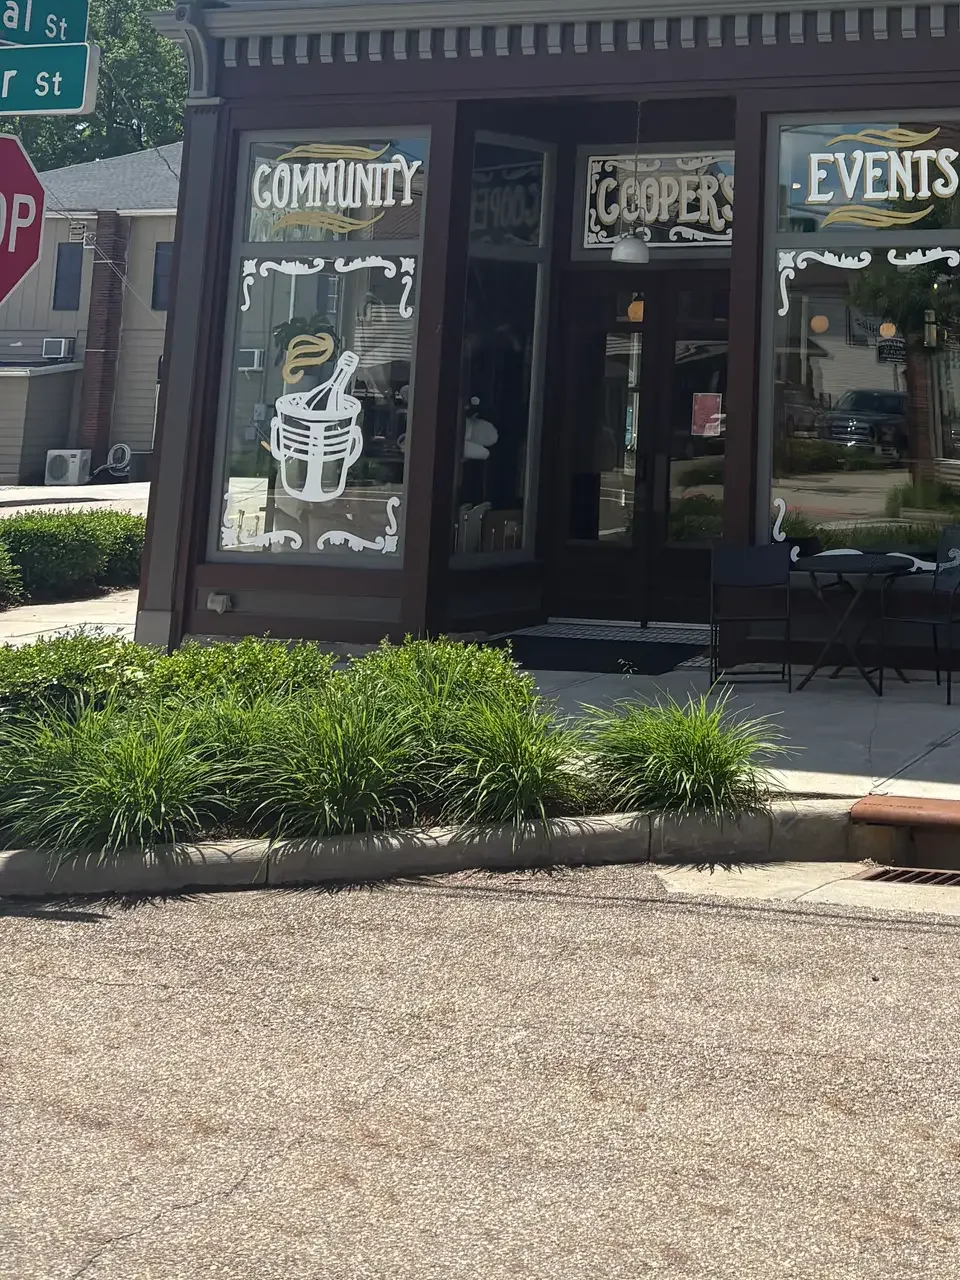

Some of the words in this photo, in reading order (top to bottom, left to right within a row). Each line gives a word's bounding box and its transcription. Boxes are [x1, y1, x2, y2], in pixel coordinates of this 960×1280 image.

[45, 14, 68, 41] St
[1, 70, 18, 98] r
[34, 71, 62, 97] St
[252, 153, 423, 209] COMMUNITY
[805, 147, 960, 204] EVENTS
[0, 192, 36, 253] P
